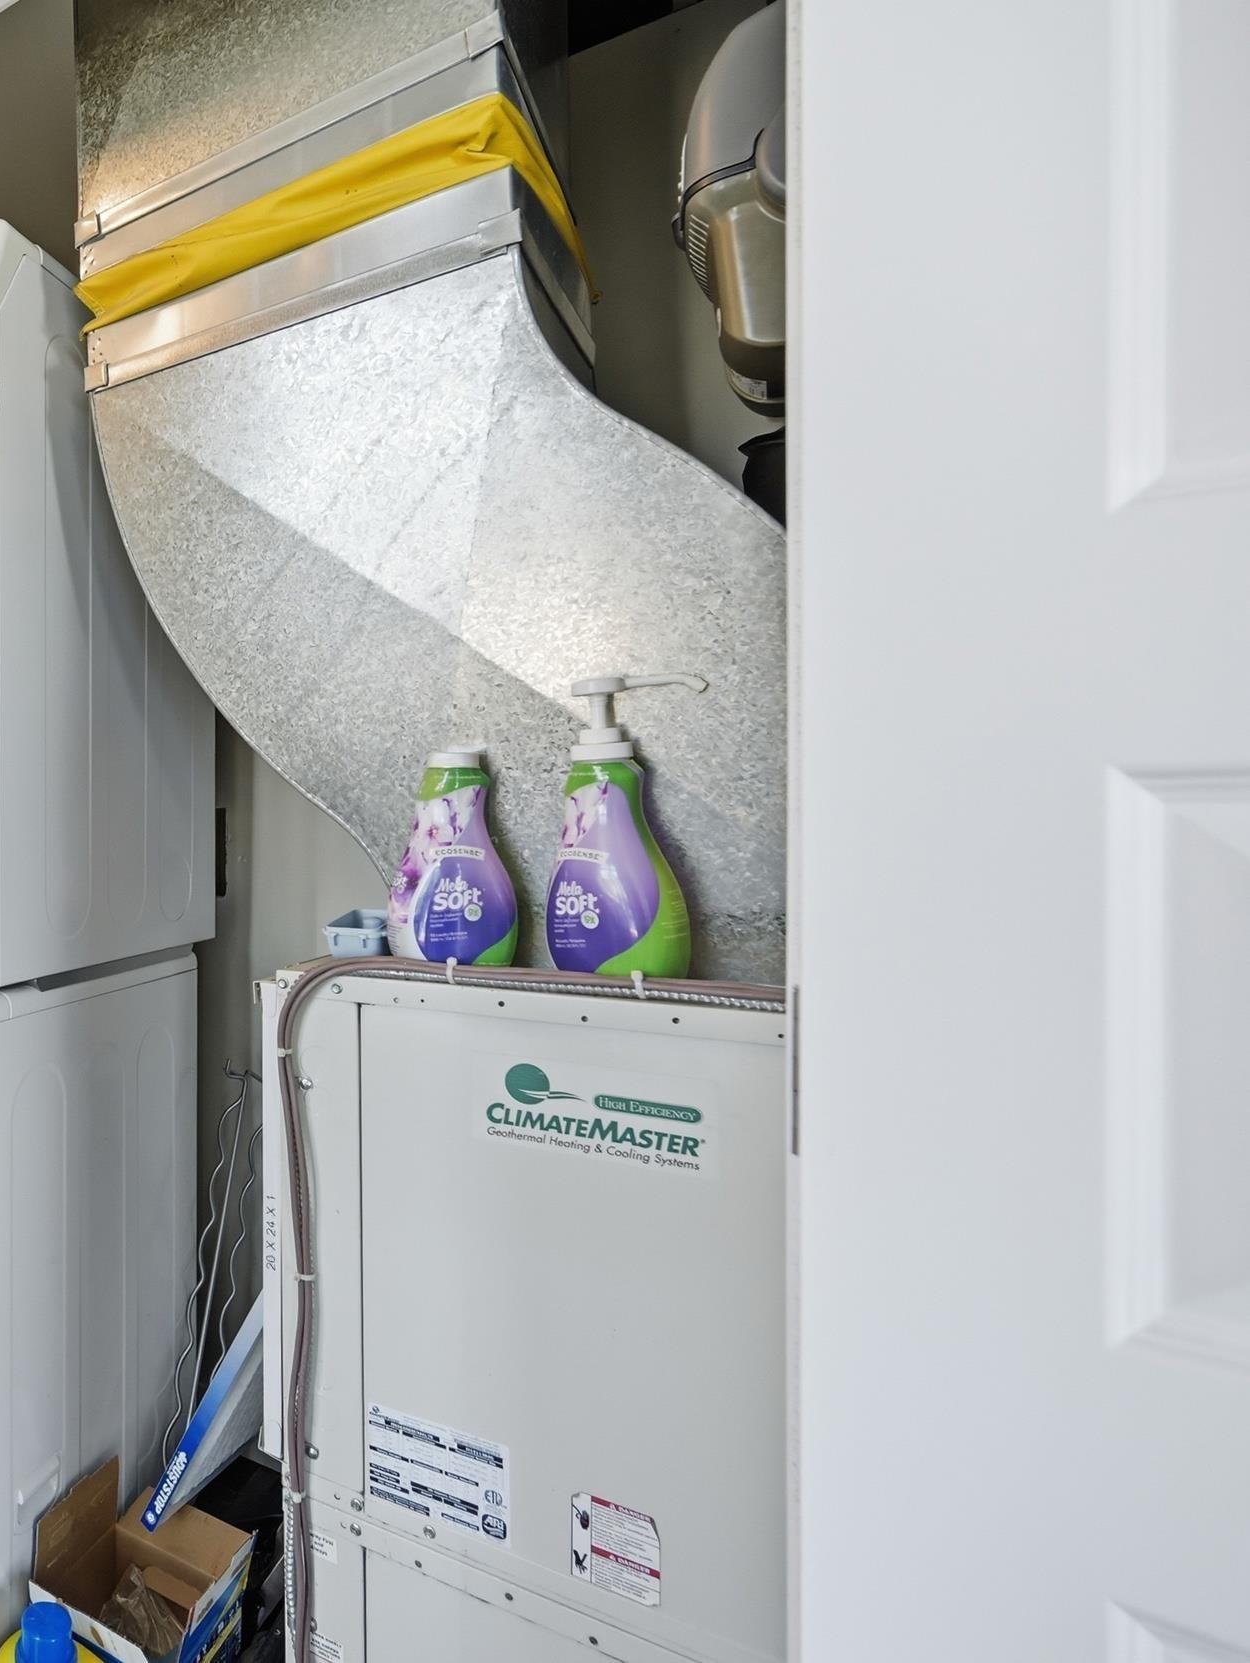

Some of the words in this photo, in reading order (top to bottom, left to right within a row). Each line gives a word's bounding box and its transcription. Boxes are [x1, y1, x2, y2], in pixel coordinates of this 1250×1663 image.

[486, 1126, 546, 1144] Geothermal
[550, 1137, 591, 1154] Heating
[594, 1143, 603, 1153] &
[606, 1145, 651, 1164] Cooling
[654, 1153, 700, 1171] Systems
[265, 1254, 276, 1271] 20
[154, 1458, 187, 1515] DUSTSTOP
